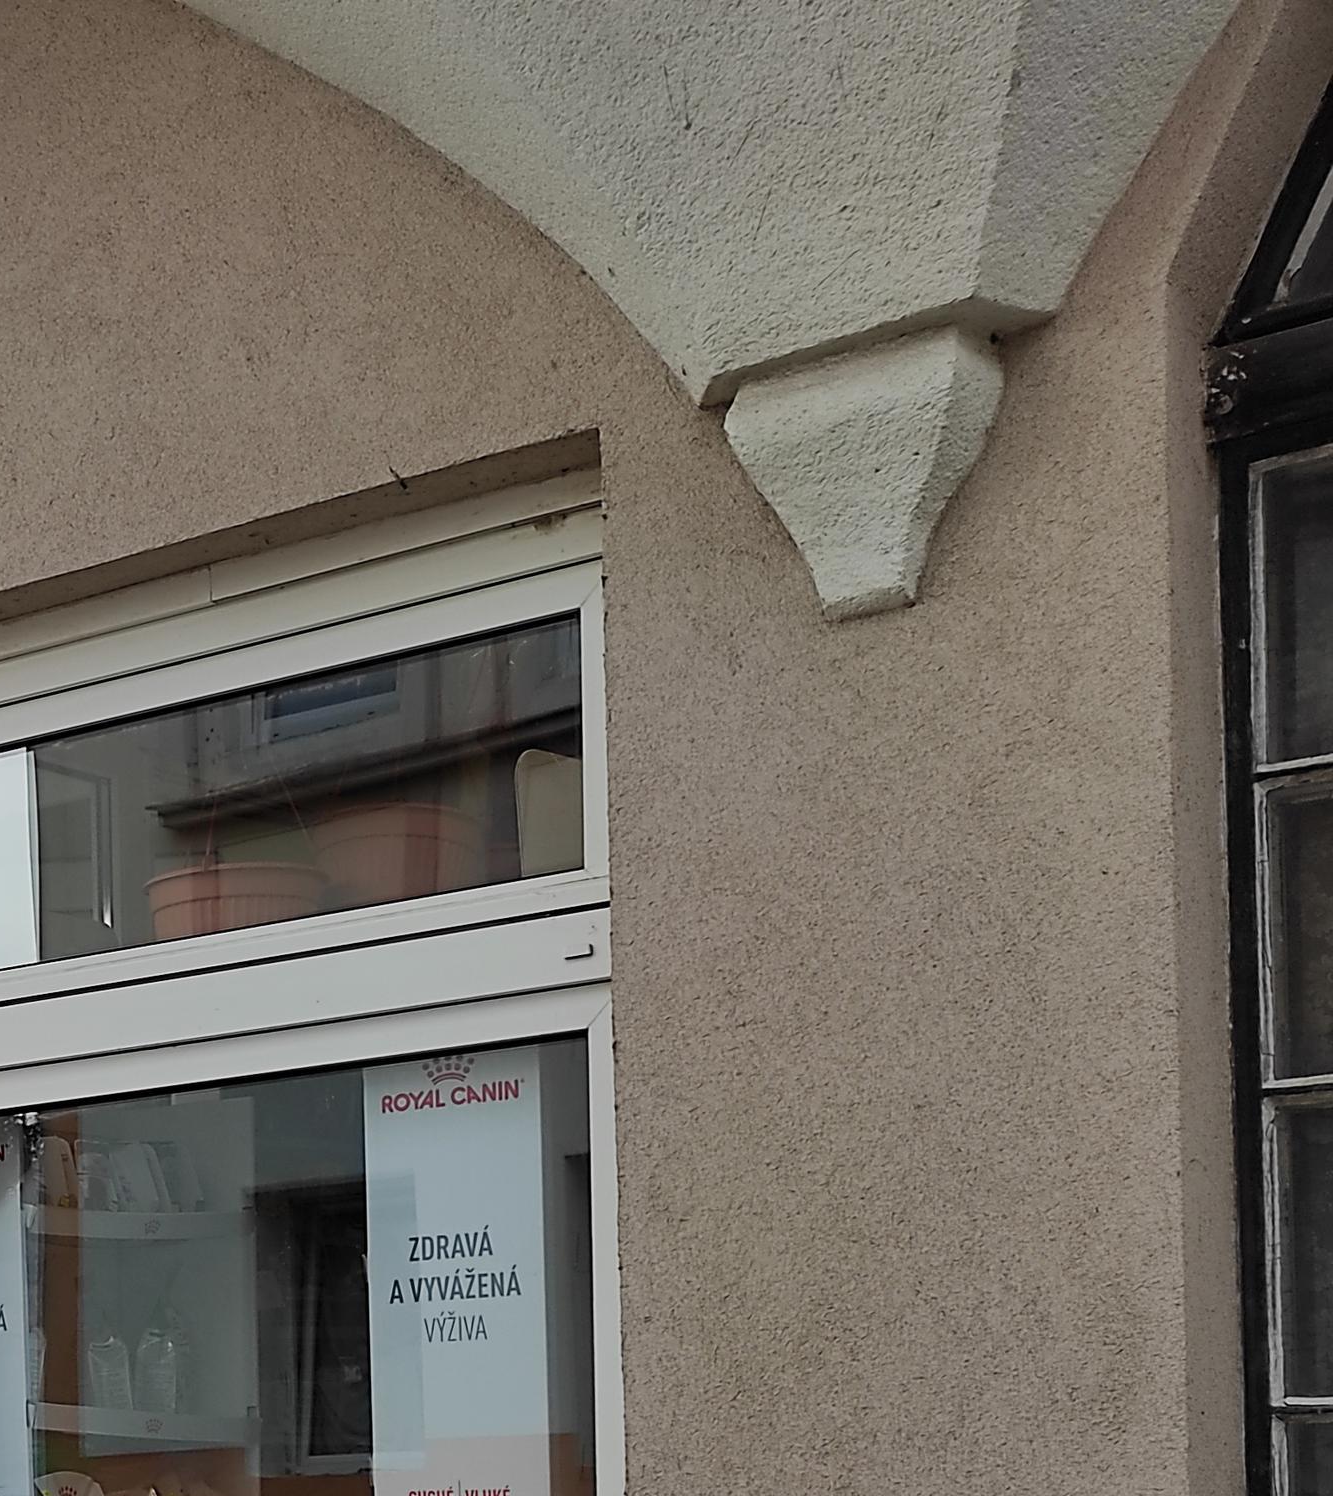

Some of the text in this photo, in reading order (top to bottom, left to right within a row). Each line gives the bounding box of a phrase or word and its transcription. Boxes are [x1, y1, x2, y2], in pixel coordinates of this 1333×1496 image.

[382, 1079, 520, 1113] ROYAL CANIN
[408, 1225, 493, 1262] ZDRAVÁ
[389, 1264, 521, 1304] A VYVÁŽENÁ
[424, 1311, 488, 1343] VÝŽIVA
